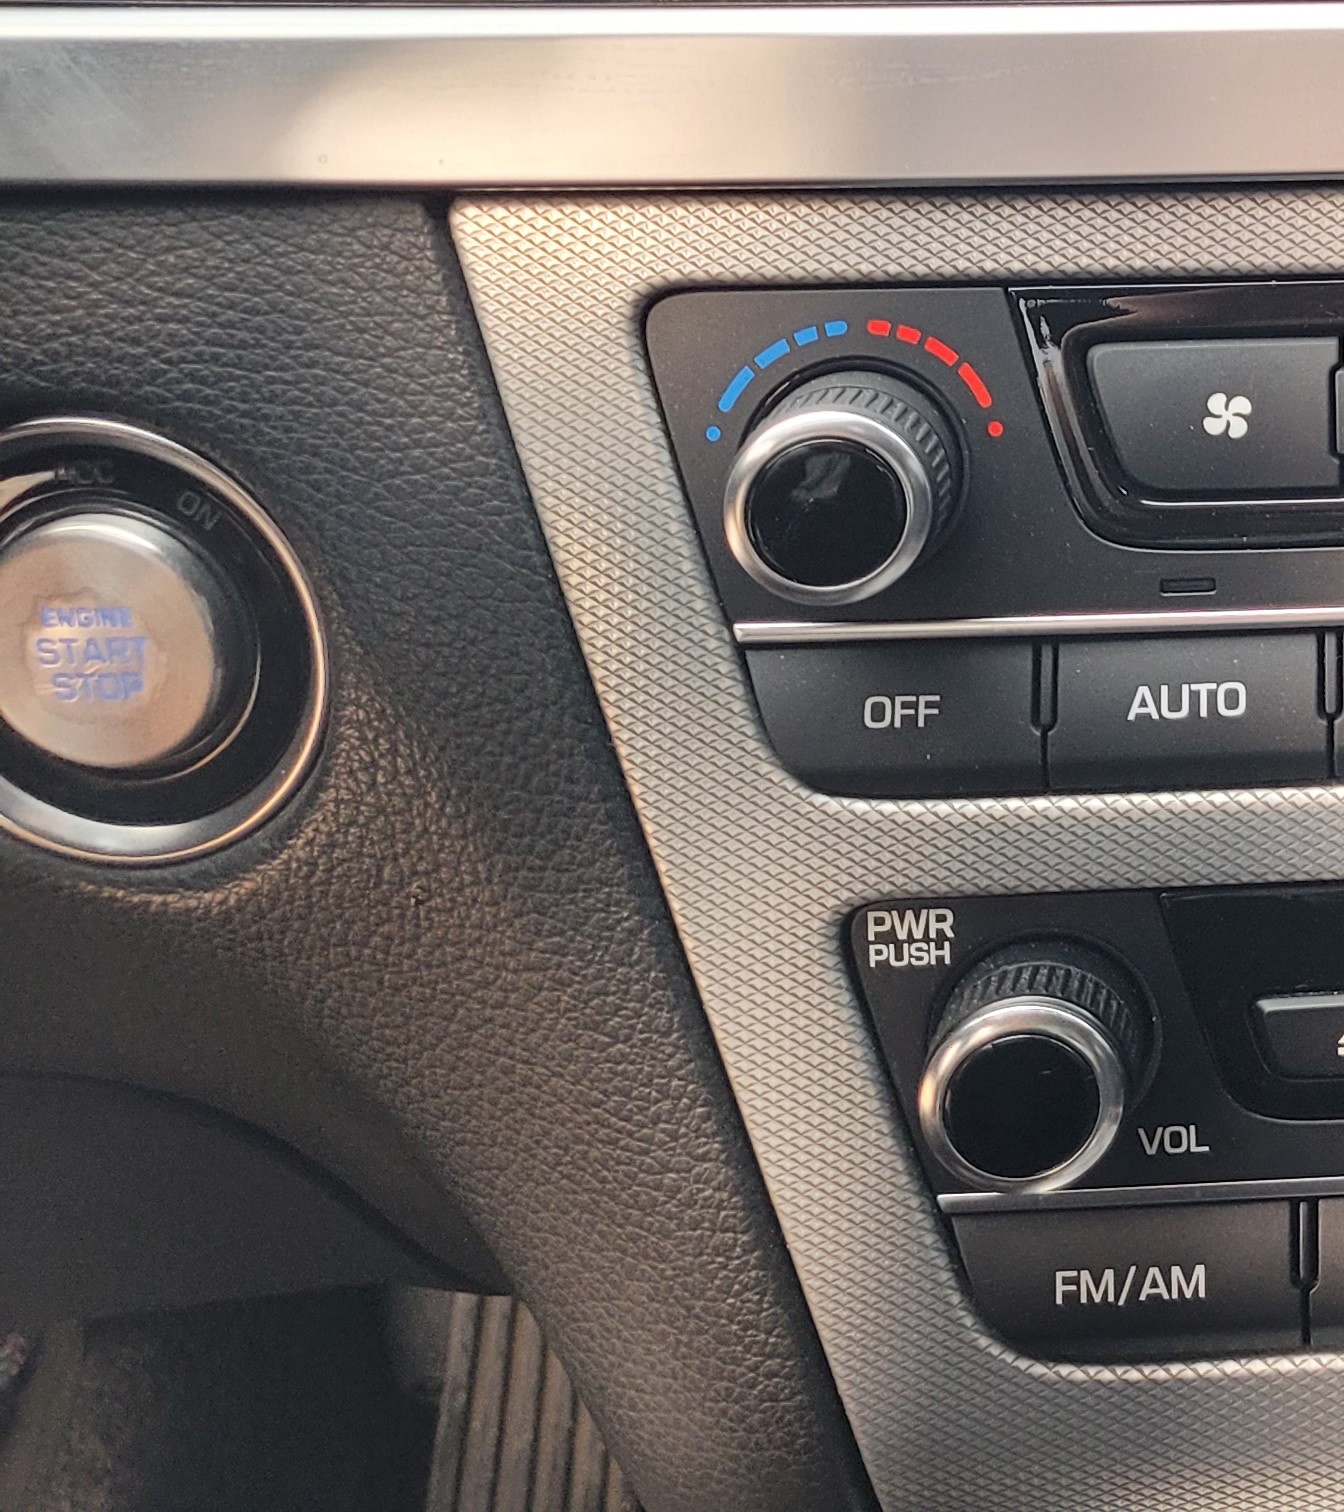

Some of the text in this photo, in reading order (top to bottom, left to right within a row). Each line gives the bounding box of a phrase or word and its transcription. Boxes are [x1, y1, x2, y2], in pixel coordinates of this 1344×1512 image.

[41, 607, 133, 629] ENGINE
[35, 636, 150, 668] START
[51, 673, 145, 702] STOP
[1127, 681, 1247, 721] AUTO
[863, 695, 941, 729] OFF
[867, 908, 955, 942] PWR
[868, 941, 951, 968] PUSH
[1138, 1124, 1210, 1155] VOL
[1055, 1264, 1206, 1306] FM/AM
